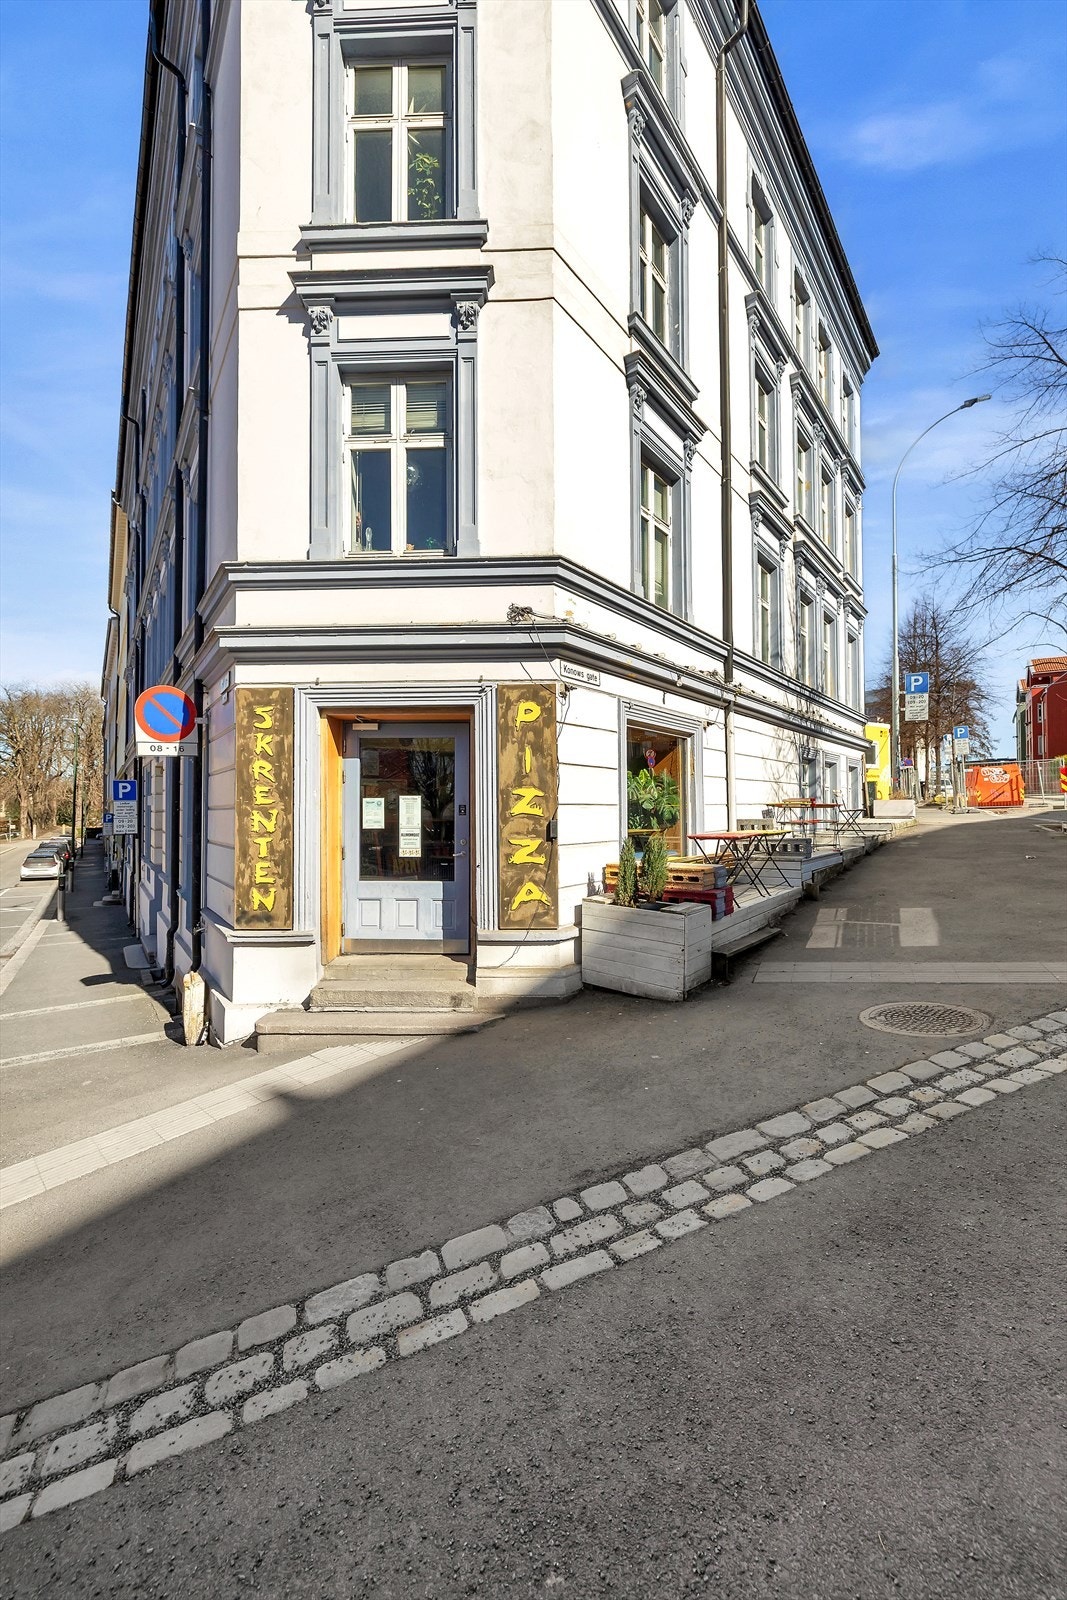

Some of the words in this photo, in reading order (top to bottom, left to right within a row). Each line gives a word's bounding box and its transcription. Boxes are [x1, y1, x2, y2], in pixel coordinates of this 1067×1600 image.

[564, 664, 585, 679] Konows
[587, 673, 598, 682] gate
[911, 675, 923, 692] P
[957, 728, 965, 738] P
[173, 745, 185, 753] 16
[118, 782, 131, 799] P
[251, 705, 279, 912] SKRENTEN
[507, 701, 551, 911] PIZZA
[105, 814, 112, 822] P
